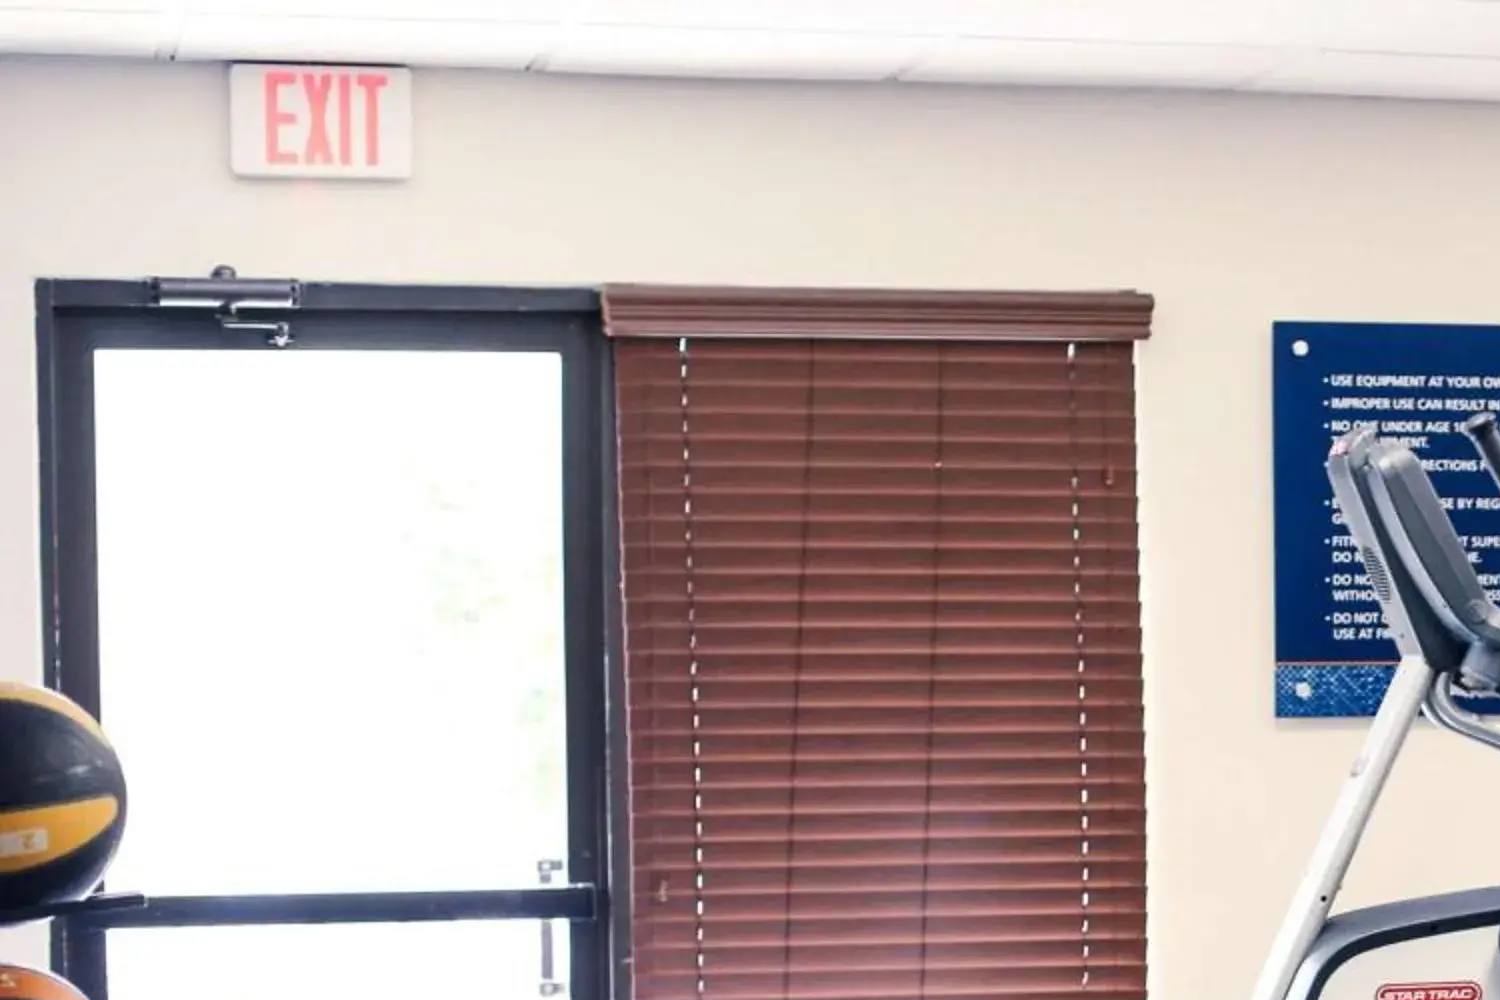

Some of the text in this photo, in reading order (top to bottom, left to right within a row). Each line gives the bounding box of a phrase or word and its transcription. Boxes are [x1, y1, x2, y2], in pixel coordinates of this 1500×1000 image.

[264, 71, 389, 166] EXIT
[1331, 374, 1354, 388] USE
[1356, 374, 1426, 389] EQUIPMENT
[1427, 375, 1444, 388] AT
[1445, 375, 1481, 389] YOUR
[1331, 396, 1390, 410] IMPROPER
[1392, 397, 1415, 411] USE
[1417, 398, 1443, 411] CAN
[1444, 399, 1486, 412] RESULT
[1487, 399, 1500, 412] IN
[1331, 419, 1351, 433] NO
[1381, 420, 1423, 434] UNDER
[1425, 421, 1451, 434] AGE
[1457, 497, 1475, 511] BY
[1332, 551, 1353, 564] DO
[1332, 573, 1353, 587] DO
[1333, 611, 1353, 625] DO
[1353, 611, 1380, 625] NOT
[1333, 627, 1356, 640] USE
[1358, 627, 1374, 640] AT
[1428, 989, 1474, 1000] TRAC
